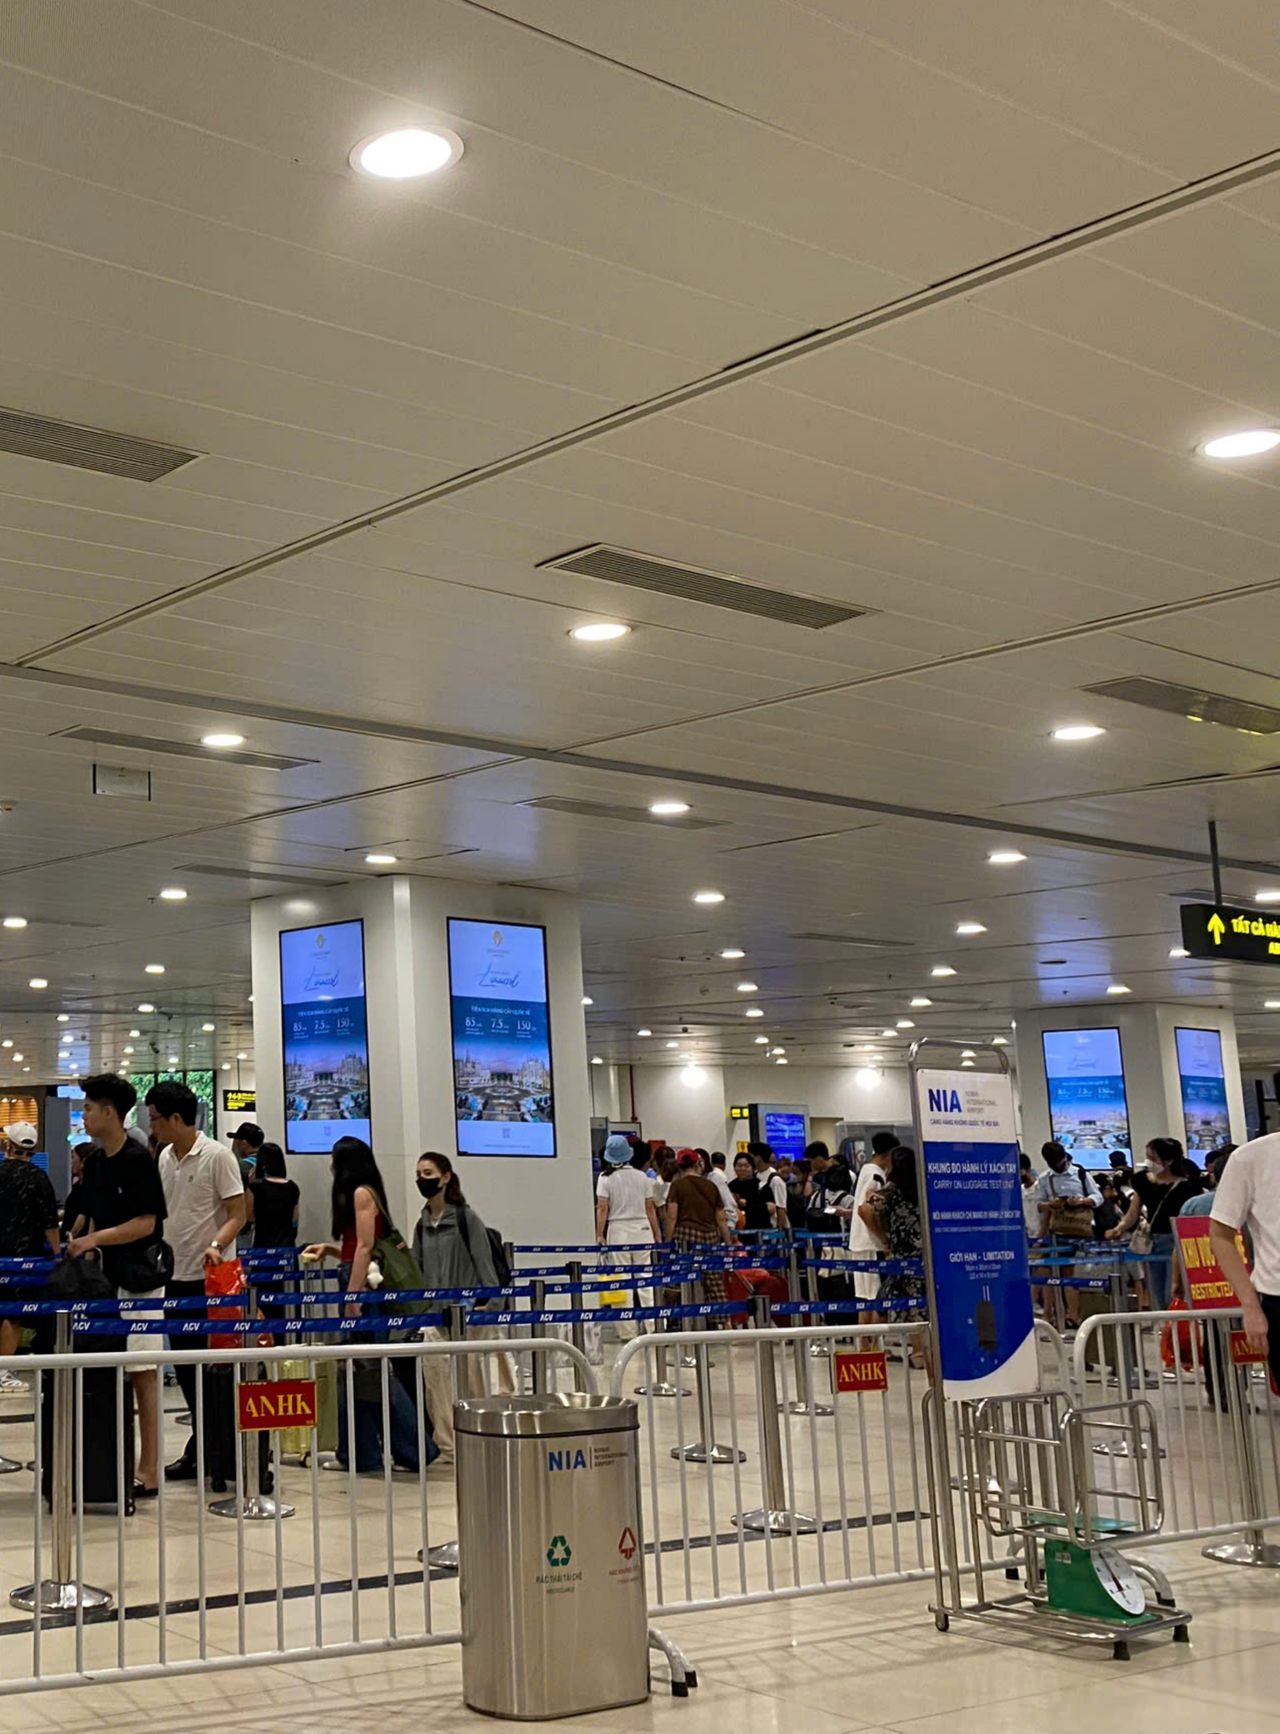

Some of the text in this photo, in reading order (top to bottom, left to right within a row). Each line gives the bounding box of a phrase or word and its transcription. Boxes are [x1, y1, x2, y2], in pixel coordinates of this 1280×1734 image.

[1231, 915, 1250, 934] TẤT
[1251, 918, 1265, 936] CẢ
[929, 1089, 962, 1112] NIA
[928, 1162, 950, 1173] KHUNG
[952, 1163, 961, 1173] ĐO
[962, 1160, 979, 1173] HÀNH
[980, 1160, 988, 1173] LÝ
[989, 1160, 1006, 1173] XÁCH
[934, 1180, 953, 1189] CARRY
[954, 1180, 962, 1189] ON
[963, 1180, 988, 1189] LUGGAGE
[989, 1180, 1002, 1189] TEST
[964, 1252, 977, 1264] HẠN
[384, 1292, 397, 1300] ACV
[1191, 1281, 1234, 1300] RESTRICTED
[22, 1304, 38, 1312] ACV
[72, 1303, 87, 1311] ACV
[163, 1300, 177, 1308] ACV
[206, 1297, 221, 1305] ACV
[498, 1314, 511, 1322] ACV
[581, 1312, 593, 1320] ACV
[620, 1311, 633, 1319] ACV
[72, 1318, 403, 1331] ACV ACV ACV ACV ACV ACV ACV
[839, 1362, 884, 1382] ANHK
[246, 1394, 312, 1417] ANHK
[548, 1449, 586, 1471] NIA
